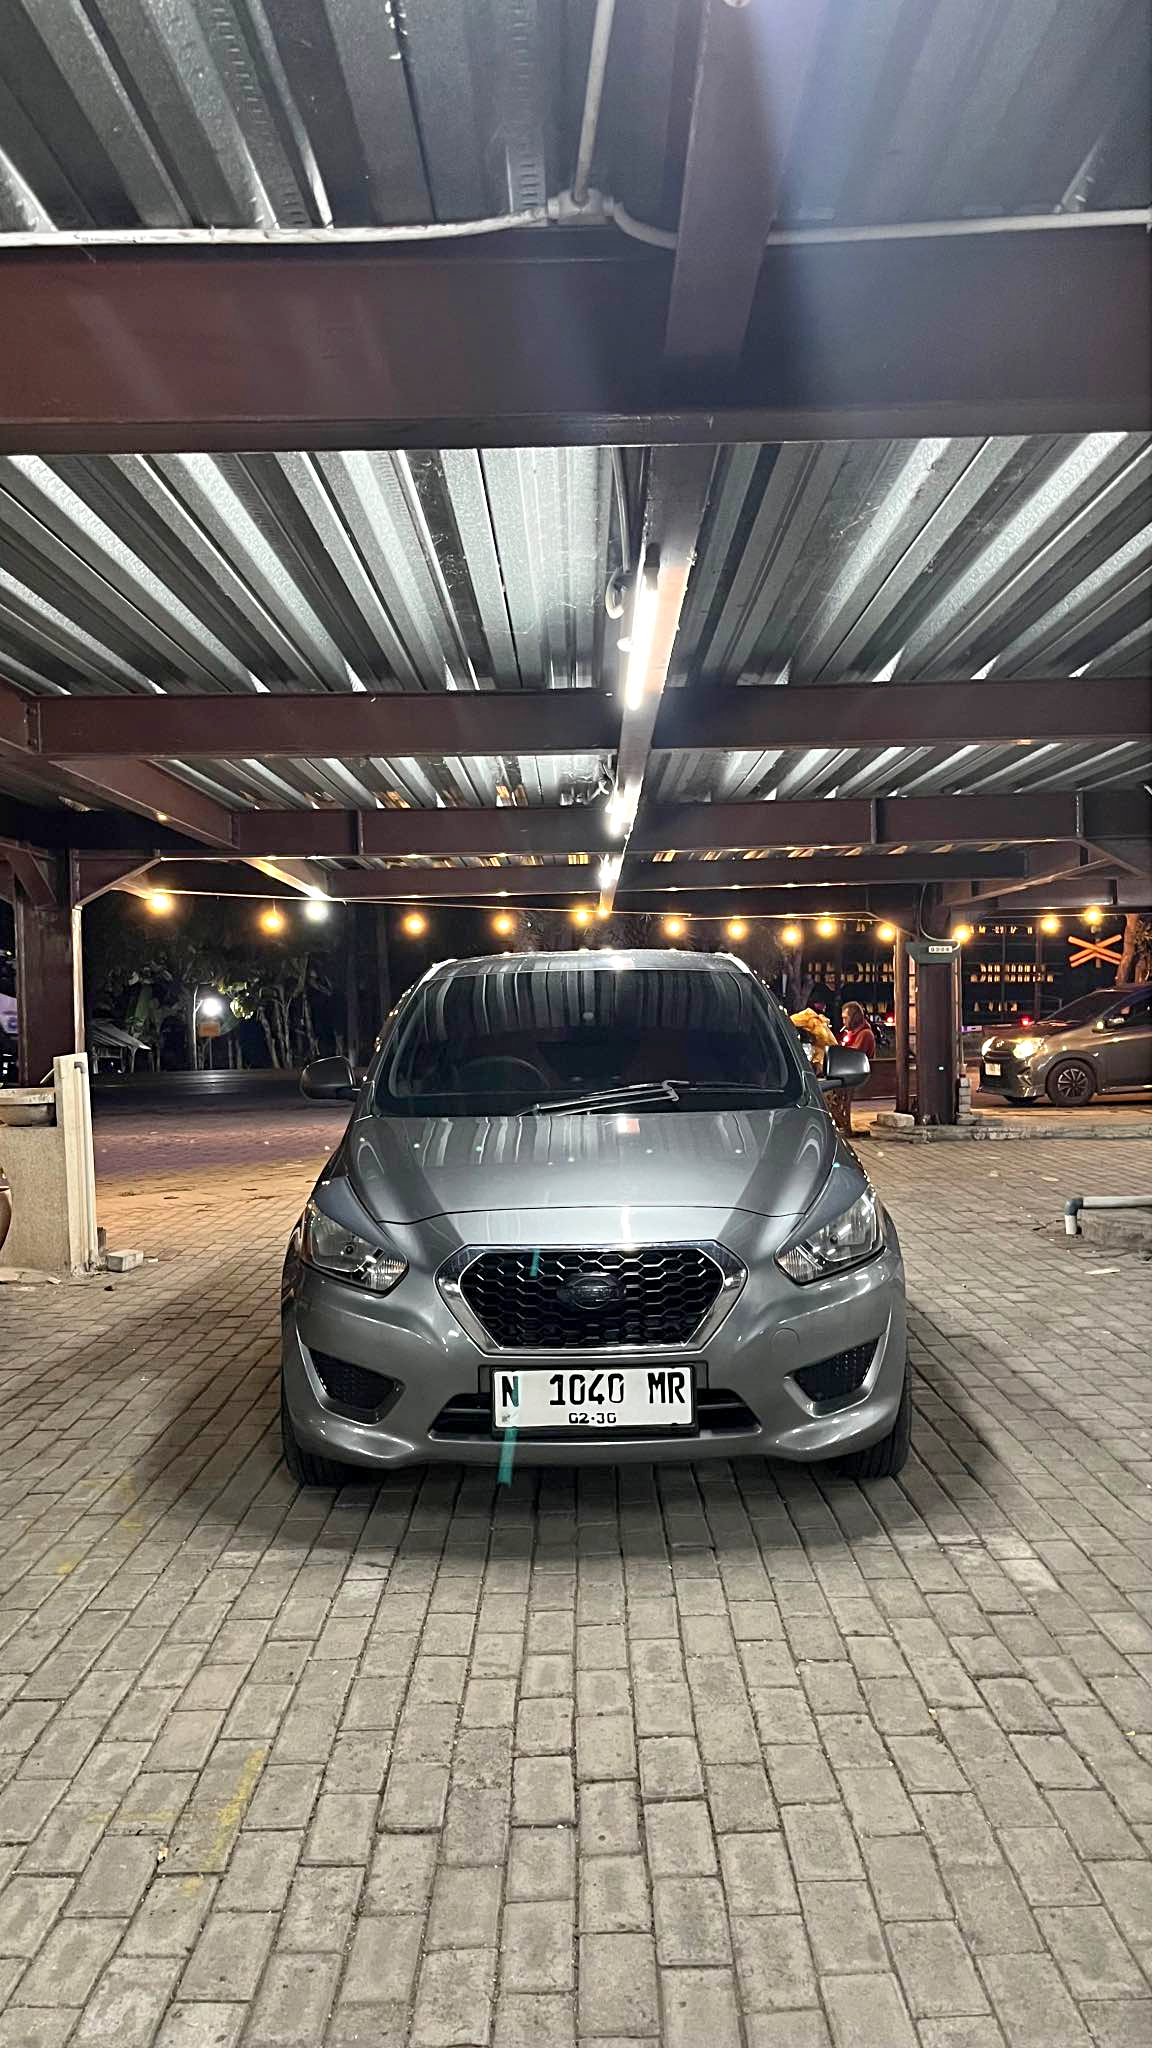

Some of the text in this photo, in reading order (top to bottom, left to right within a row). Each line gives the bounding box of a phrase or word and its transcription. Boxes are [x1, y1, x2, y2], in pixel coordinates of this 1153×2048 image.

[501, 1371, 686, 1408] N 1040 MR
